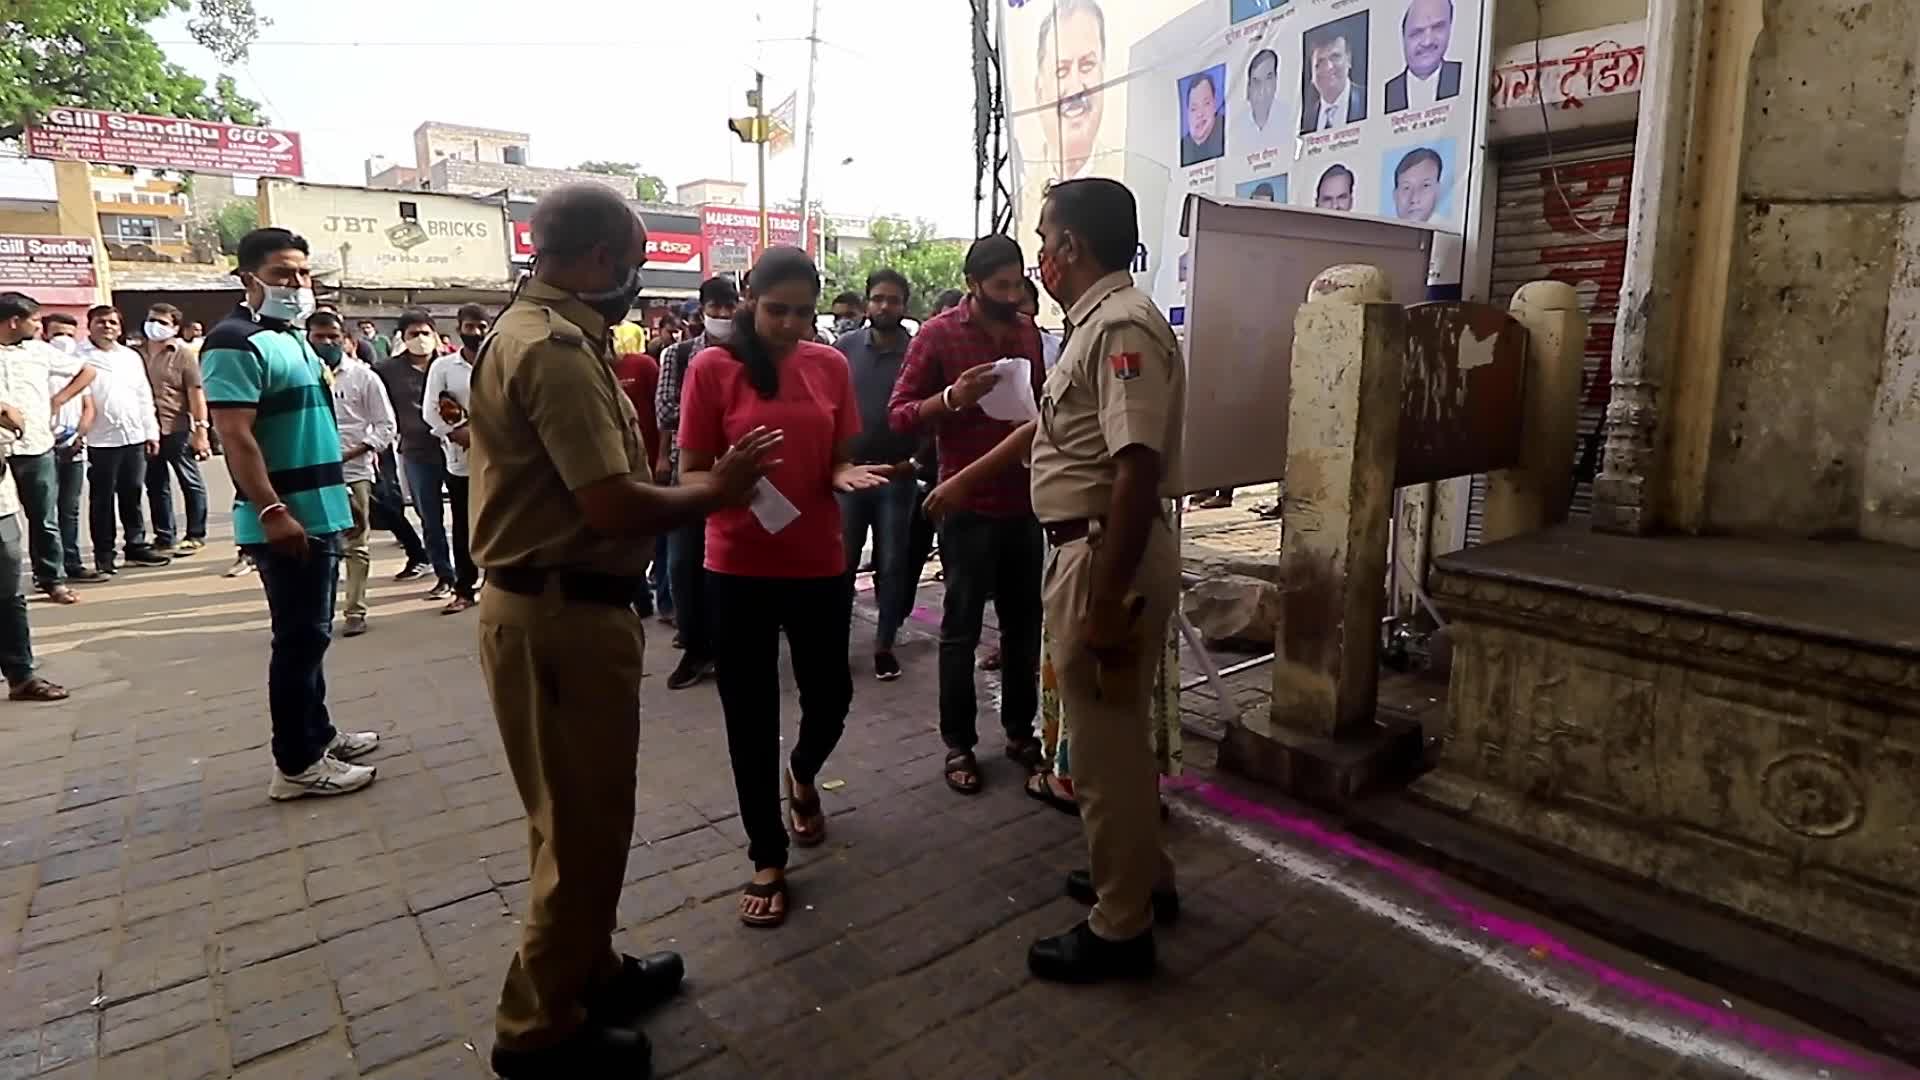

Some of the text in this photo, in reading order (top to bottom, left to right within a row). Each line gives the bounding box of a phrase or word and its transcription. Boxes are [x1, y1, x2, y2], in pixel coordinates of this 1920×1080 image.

[48, 109, 101, 129] Gill
[106, 115, 220, 140] Sandhu
[226, 127, 269, 143] GGC
[322, 215, 488, 238] JBT BRICKS
[0, 239, 92, 255] Gill Sandhu
